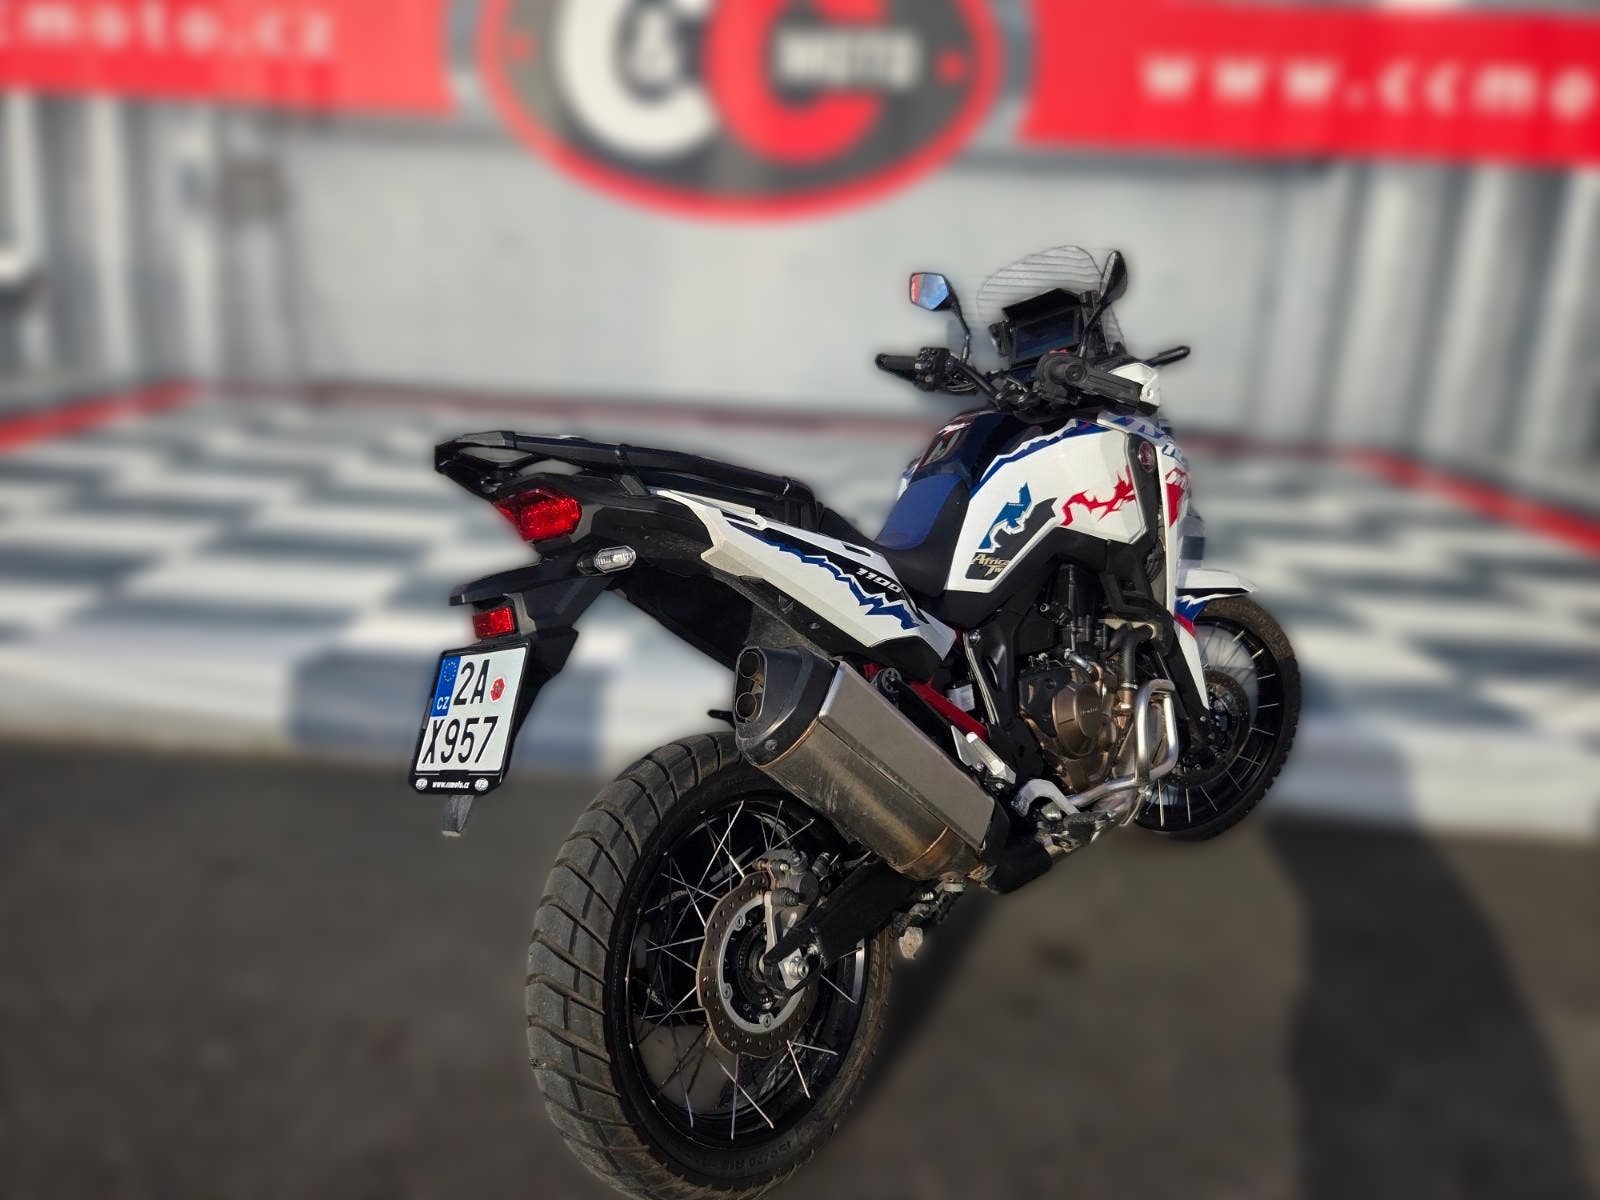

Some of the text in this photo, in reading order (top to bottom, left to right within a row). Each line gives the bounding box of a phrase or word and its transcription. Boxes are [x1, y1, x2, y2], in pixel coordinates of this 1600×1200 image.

[776, 29, 918, 89] MOTO
[855, 567, 903, 593] 1100
[436, 696, 450, 710] CZ
[453, 659, 490, 706] 2A
[422, 715, 499, 764] X957
